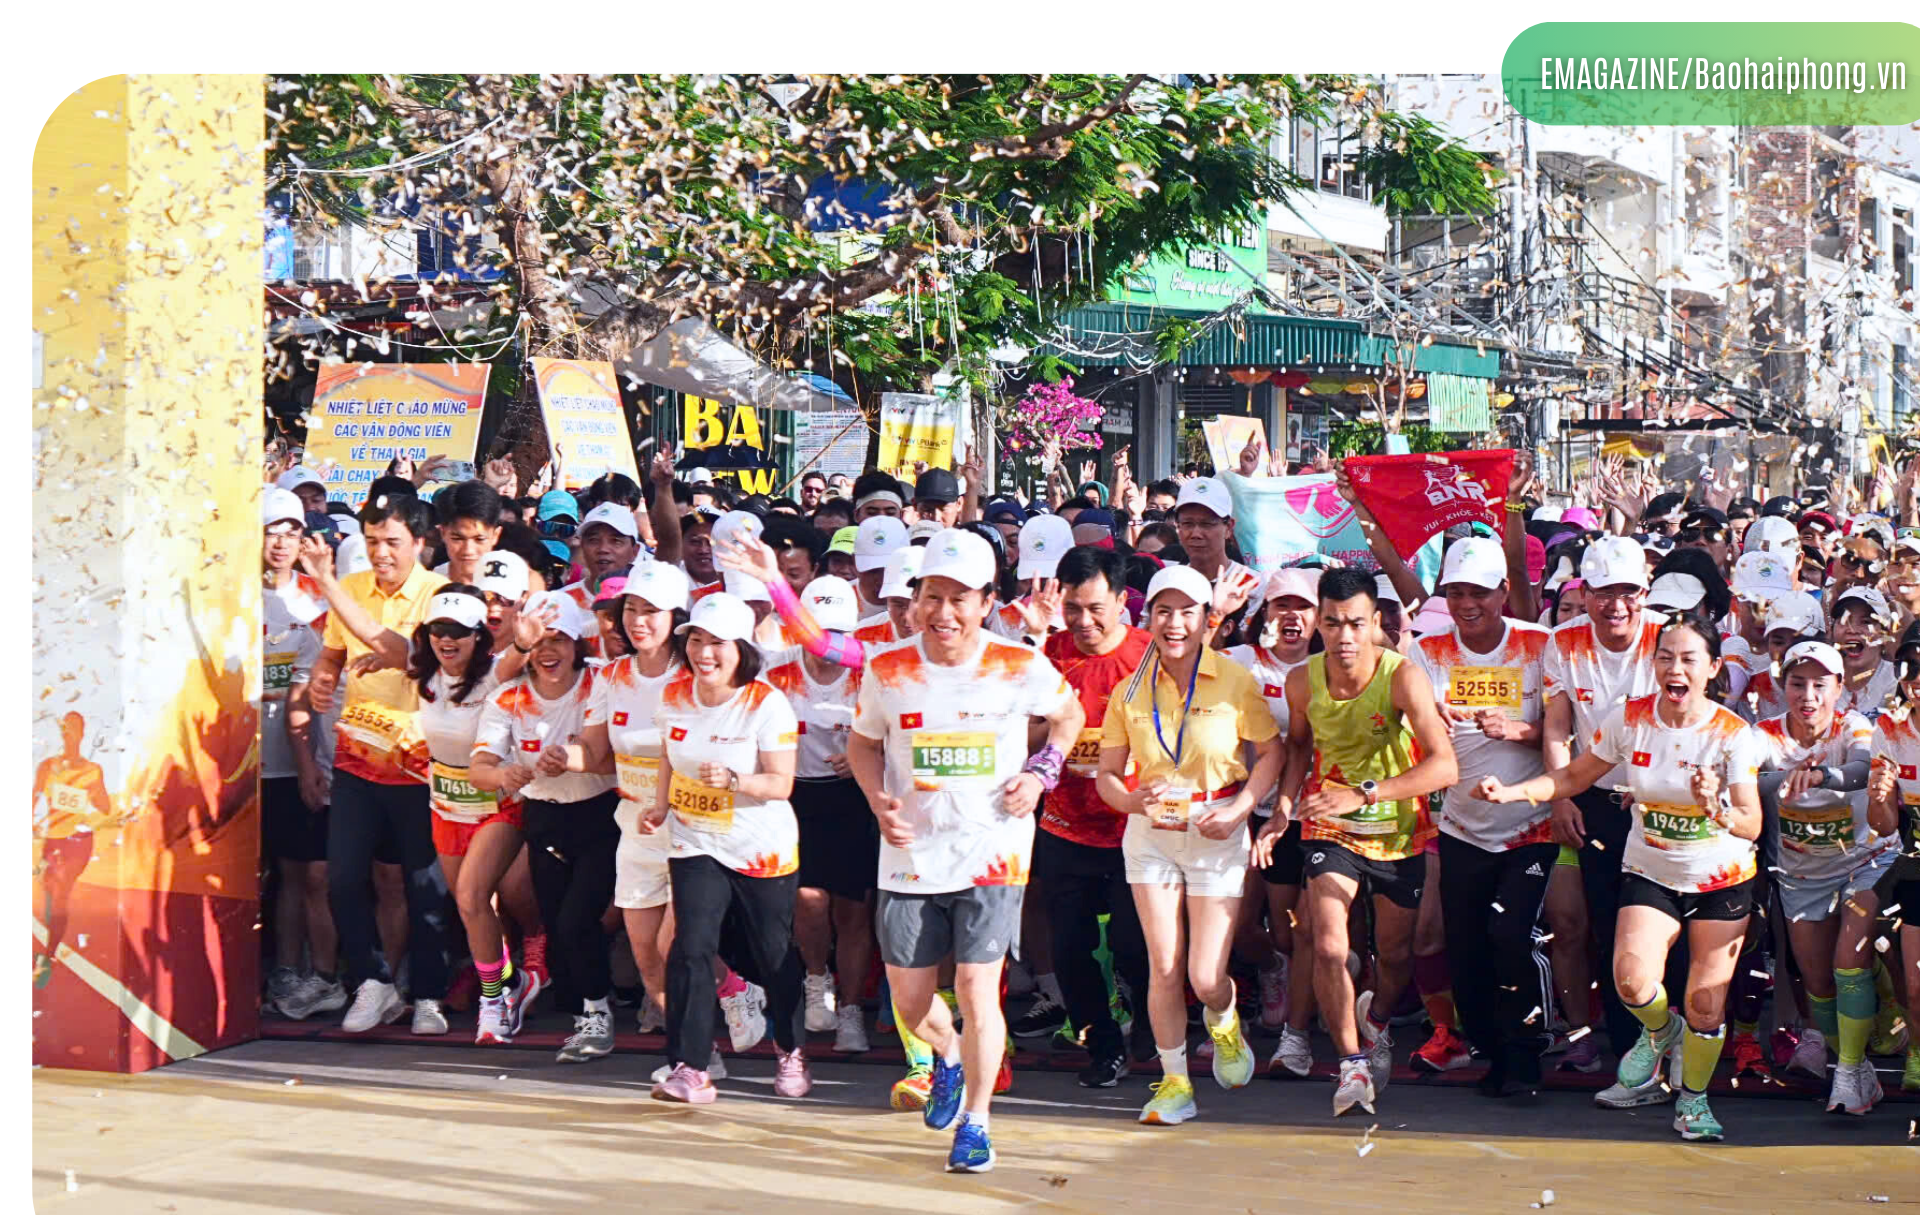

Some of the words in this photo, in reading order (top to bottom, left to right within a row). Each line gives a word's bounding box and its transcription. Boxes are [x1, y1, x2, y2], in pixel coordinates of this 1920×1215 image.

[396, 399, 429, 414] CÀO
[432, 399, 466, 414] MỪNG
[424, 422, 452, 437] VIÊN
[407, 448, 427, 460] GIA
[1424, 520, 1439, 531] VUI
[1456, 681, 1509, 697] 52555
[921, 747, 979, 766] 15888
[674, 788, 720, 812] 52186
[1651, 812, 1700, 833] 19426
